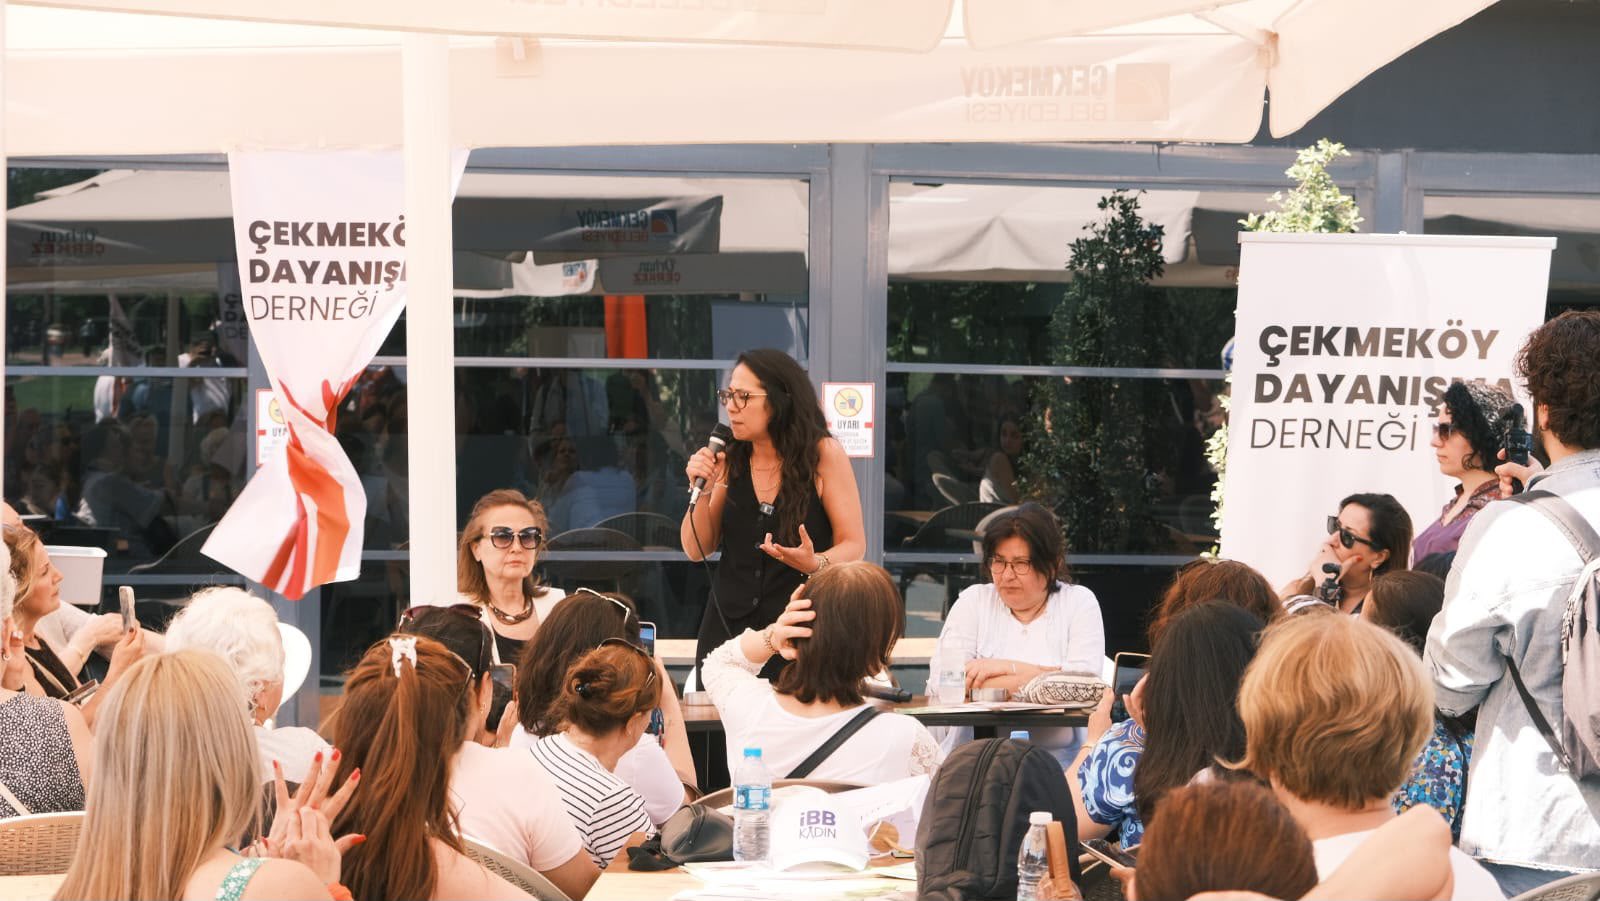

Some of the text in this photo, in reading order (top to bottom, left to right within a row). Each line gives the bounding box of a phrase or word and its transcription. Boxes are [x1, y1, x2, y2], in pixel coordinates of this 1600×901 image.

[248, 214, 406, 254] ÇEKMEKÖ
[248, 258, 407, 291] DAYANIŞ
[250, 289, 379, 321] DERNEĞİ
[1258, 319, 1500, 367] ÇEKMEKÖY
[1254, 373, 1516, 417] DAYANIŞA
[1250, 412, 1418, 451] DERNEĞİ
